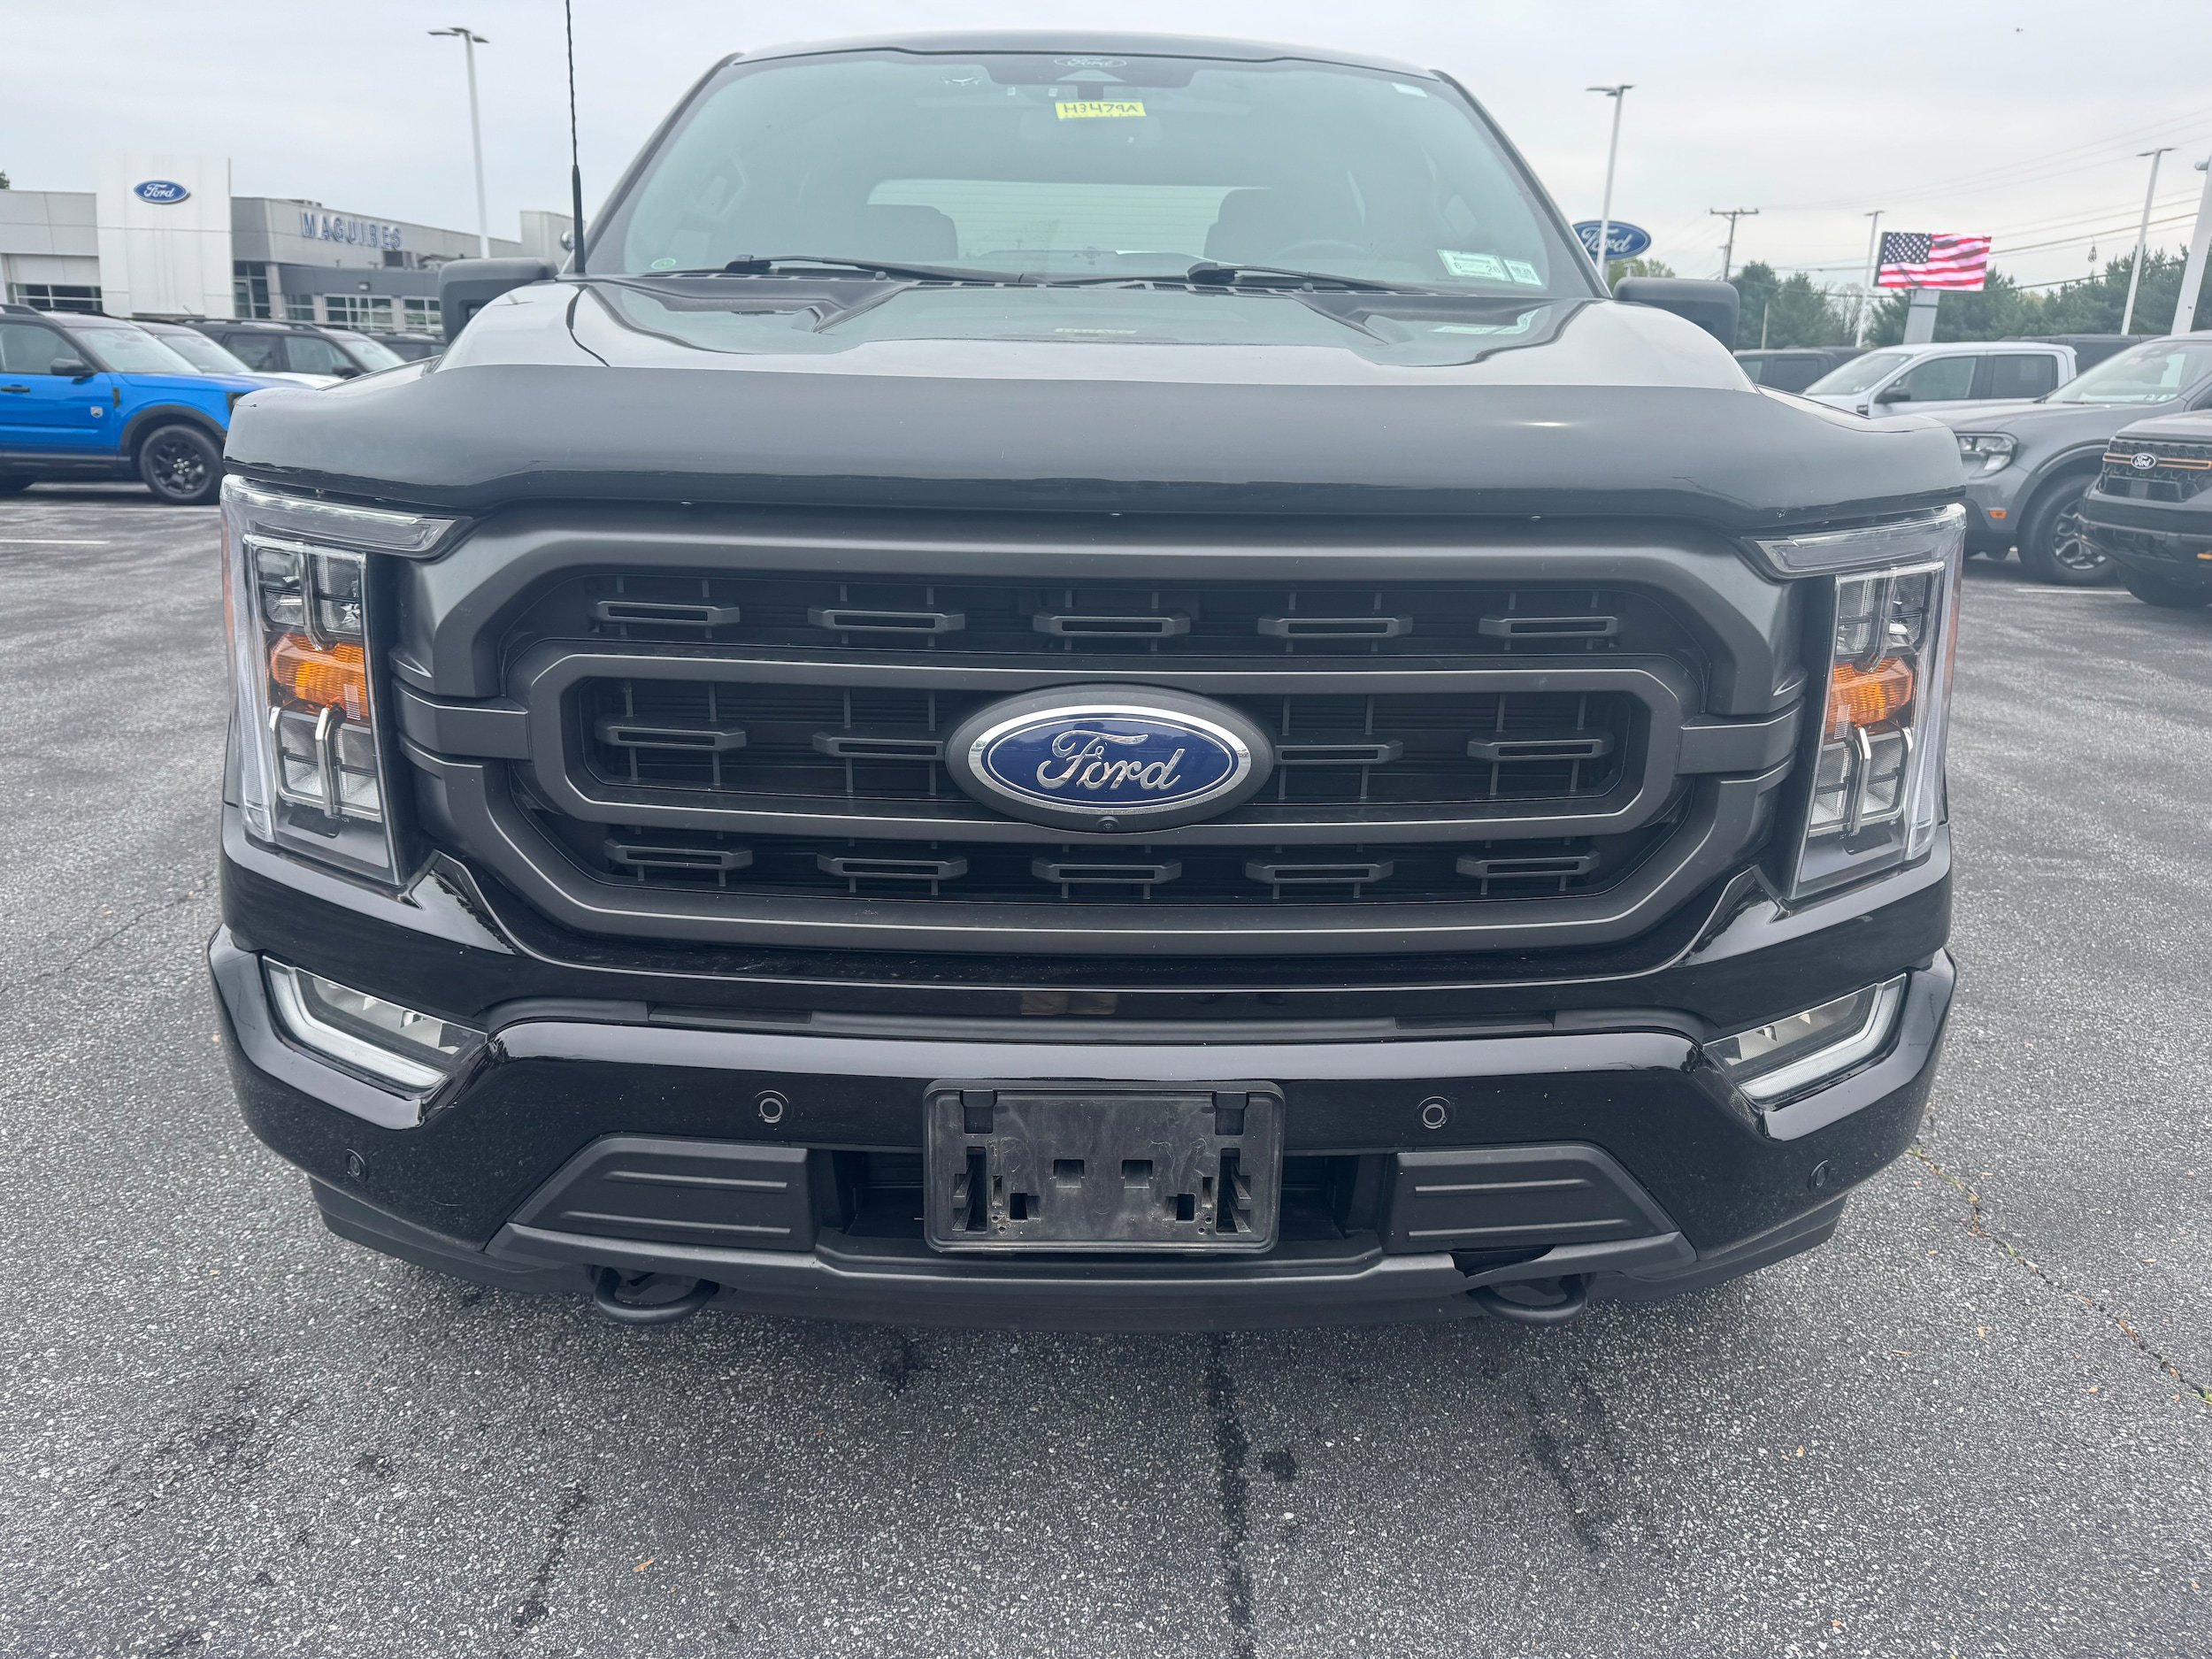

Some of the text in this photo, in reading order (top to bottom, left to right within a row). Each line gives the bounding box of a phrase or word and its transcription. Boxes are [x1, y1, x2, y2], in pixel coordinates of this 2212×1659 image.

[143, 183, 175, 198] Ford
[302, 212, 403, 250] MAGUIRES
[1036, 730, 1186, 790] Ford
